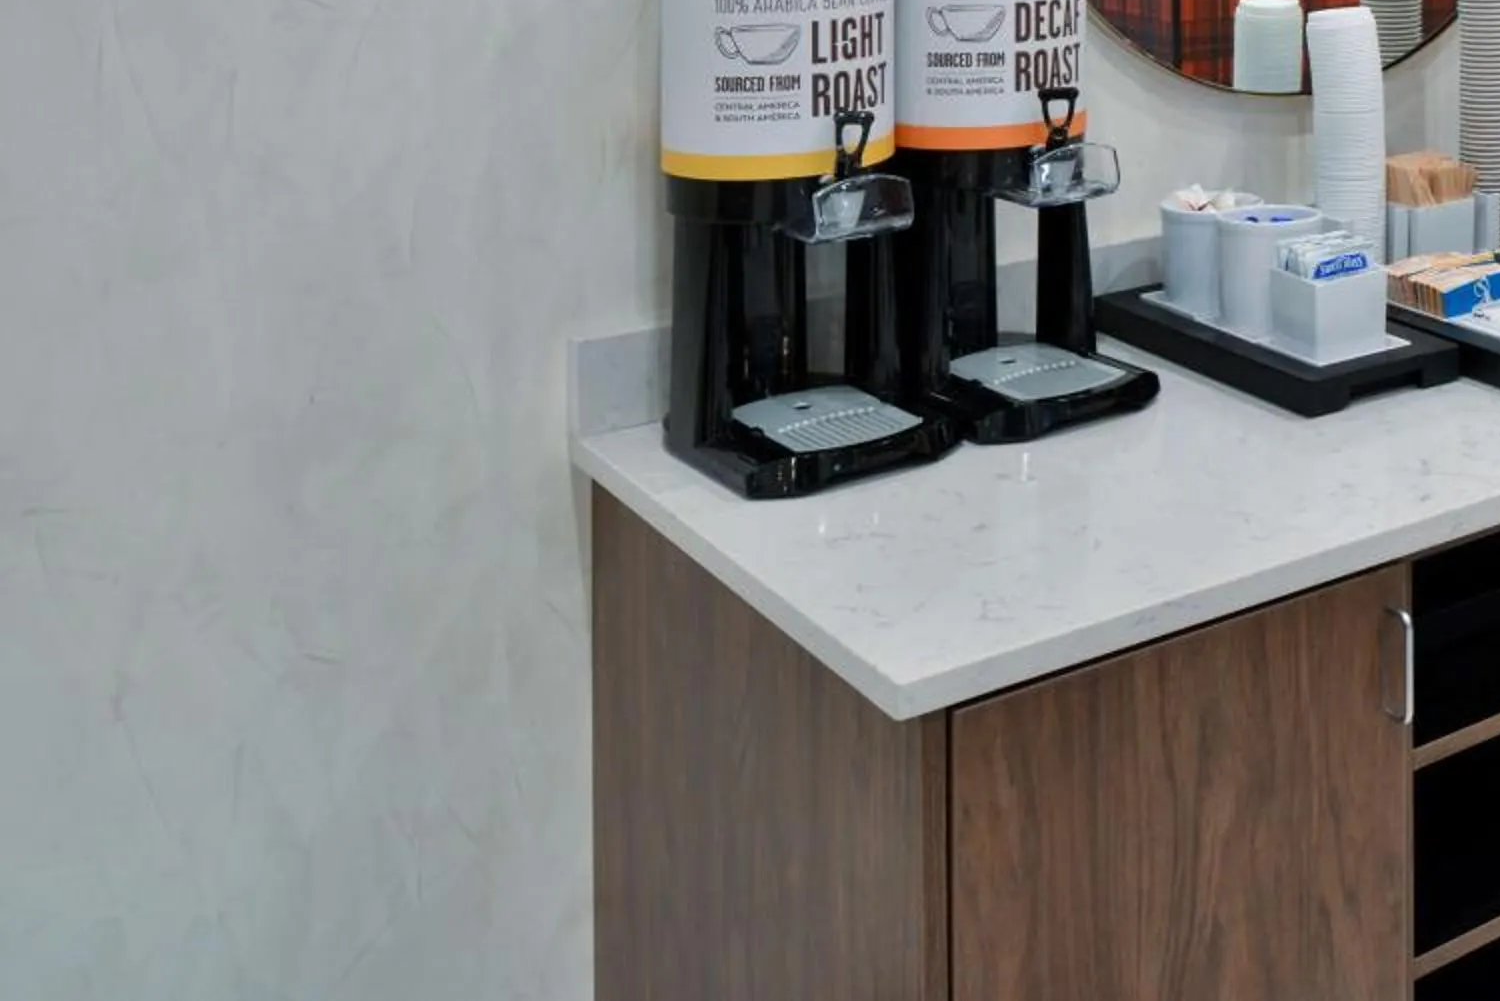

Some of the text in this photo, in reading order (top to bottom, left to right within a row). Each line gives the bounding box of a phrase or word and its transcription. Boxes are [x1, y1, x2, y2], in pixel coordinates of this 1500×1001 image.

[811, 11, 885, 65] LIGHT
[927, 52, 1005, 68] SOURCED FROM
[1014, 42, 1081, 93] ROAST
[714, 74, 801, 93] SOURCED FROM
[966, 76, 1005, 85] AMERICA
[811, 62, 887, 118] ROAST
[965, 87, 1005, 96] AMERICA
[714, 101, 801, 112] CENTRAL AMERICA
[723, 113, 755, 122] SOUTH
[757, 111, 801, 121] AMERICA
